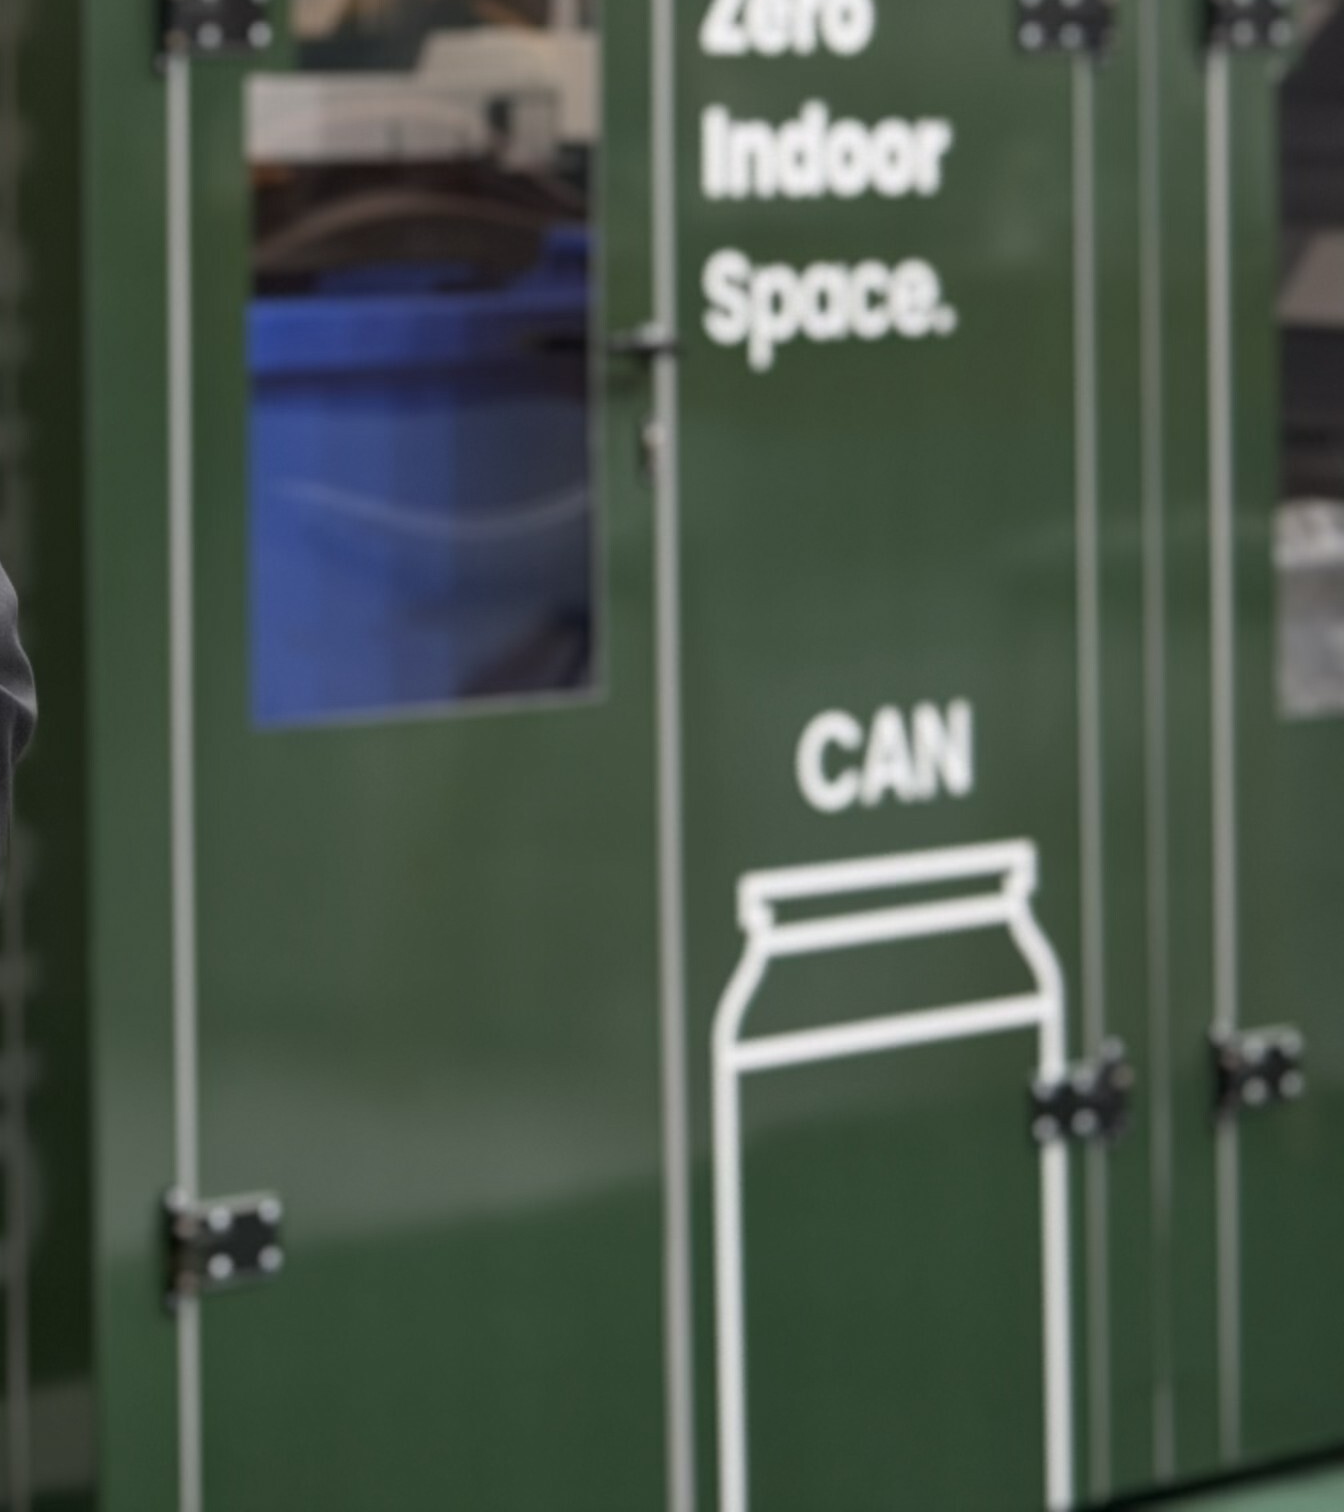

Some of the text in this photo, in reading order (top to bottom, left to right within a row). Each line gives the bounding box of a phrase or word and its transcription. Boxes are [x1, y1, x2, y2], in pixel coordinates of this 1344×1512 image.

[700, 101, 952, 199] Indoor
[702, 249, 957, 372] Space.
[795, 699, 974, 812] CAN
